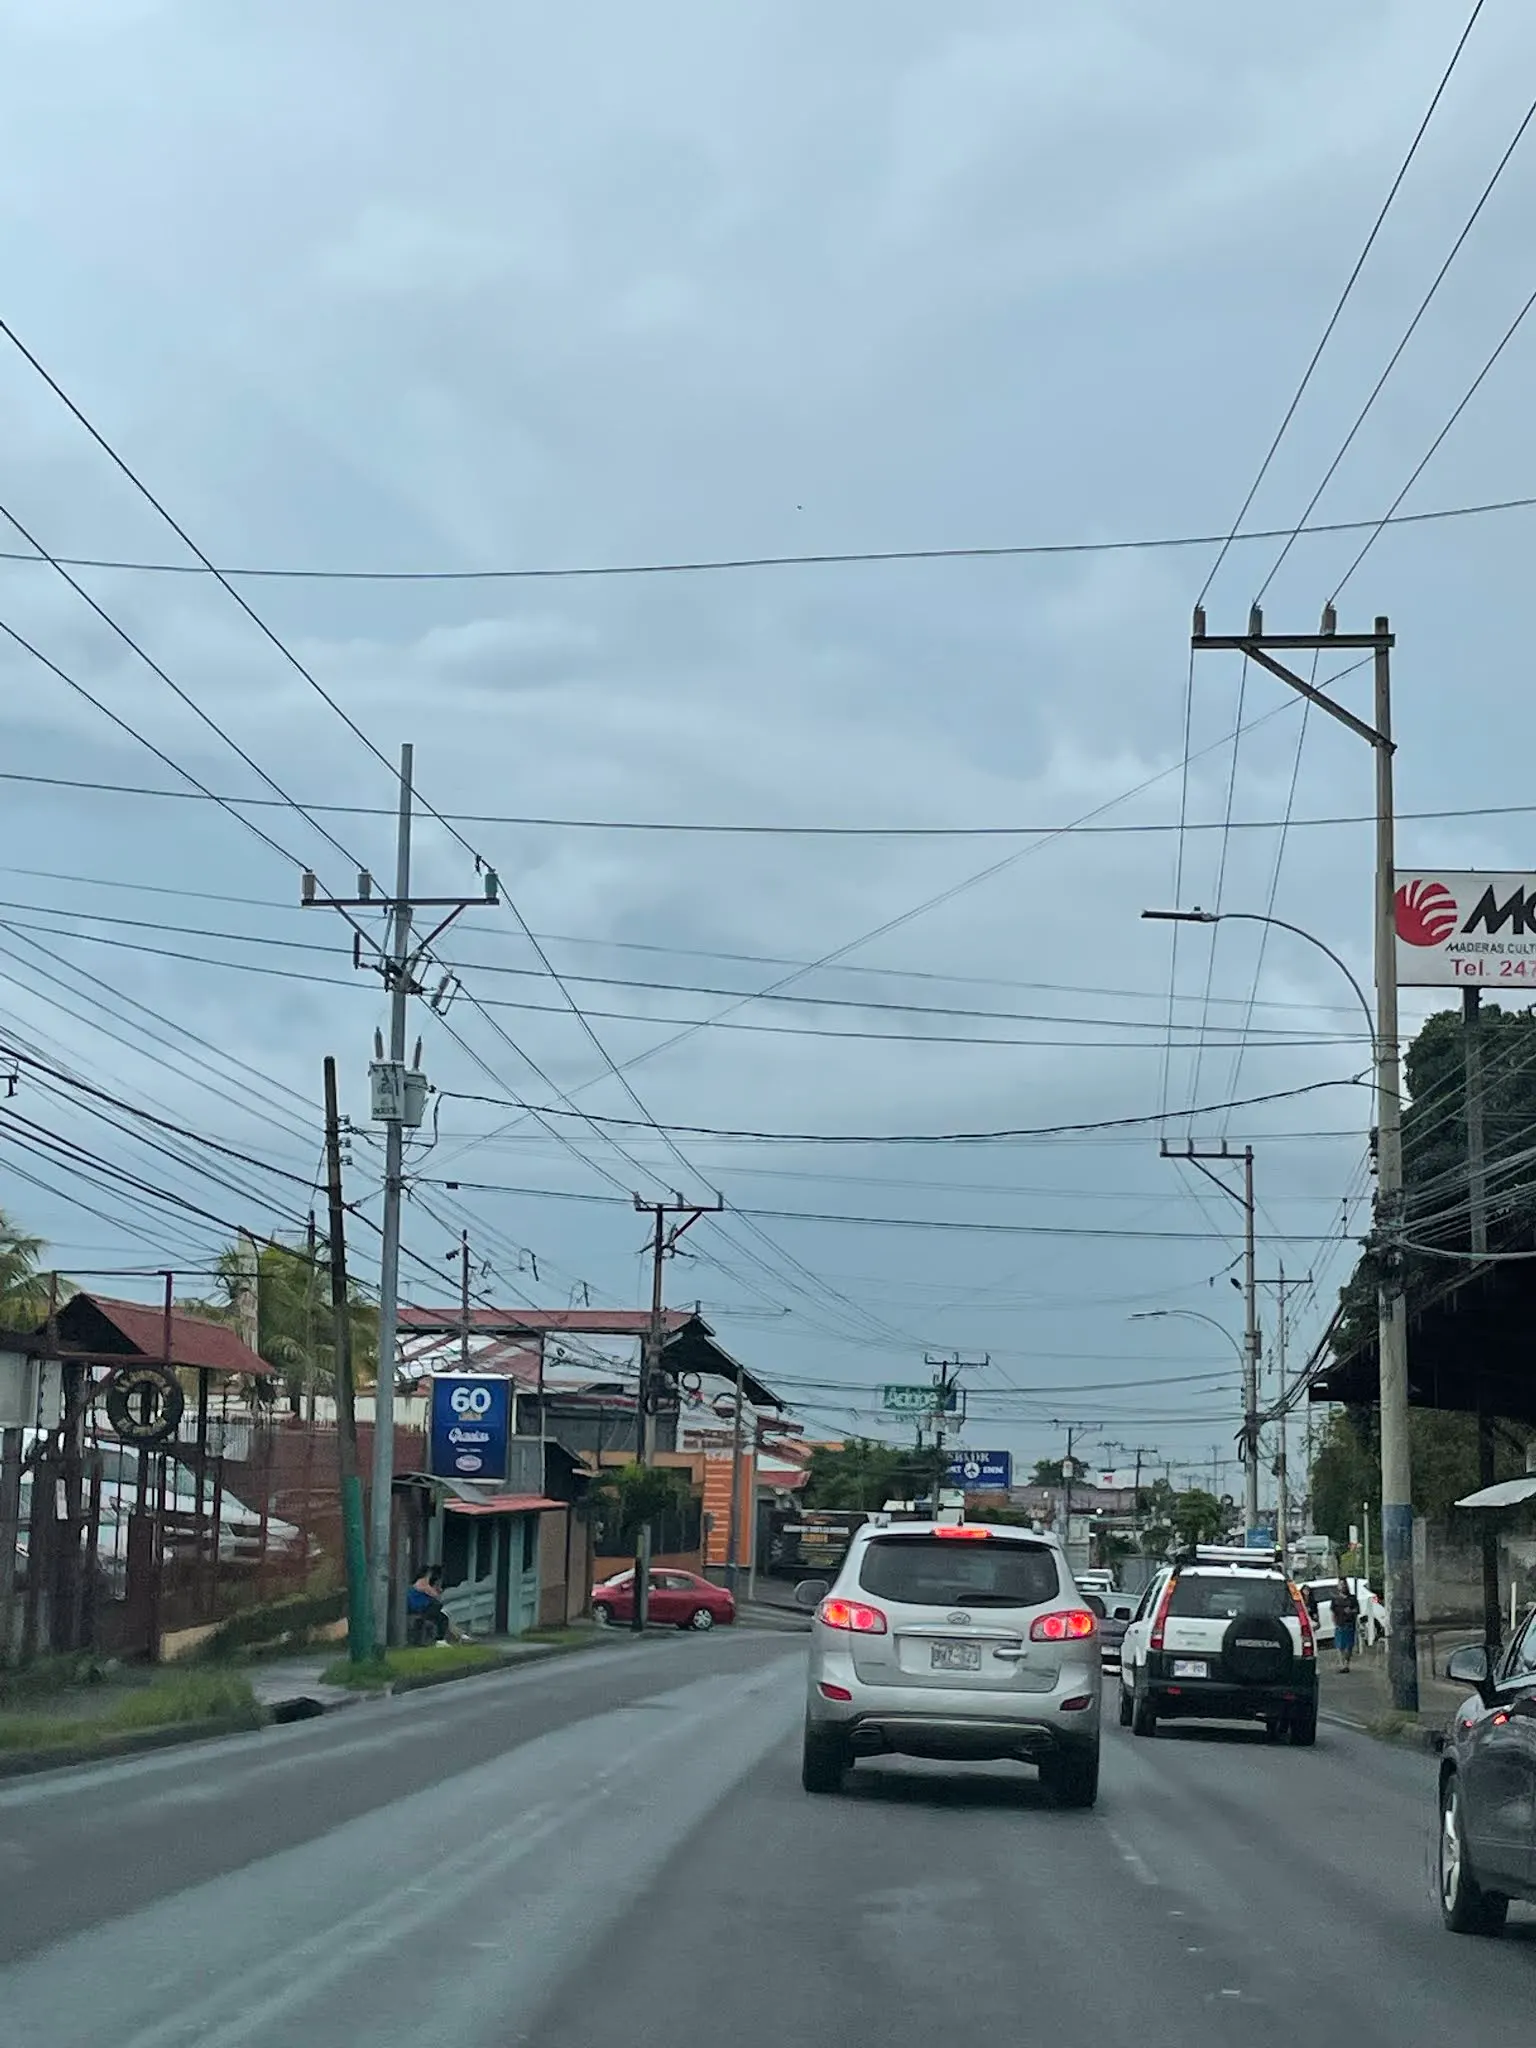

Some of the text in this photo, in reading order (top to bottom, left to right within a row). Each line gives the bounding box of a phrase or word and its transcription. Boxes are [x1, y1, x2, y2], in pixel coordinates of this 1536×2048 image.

[1460, 884, 1536, 934] M
[1445, 942, 1503, 955] MADERAS
[1450, 958, 1490, 977] Tel.
